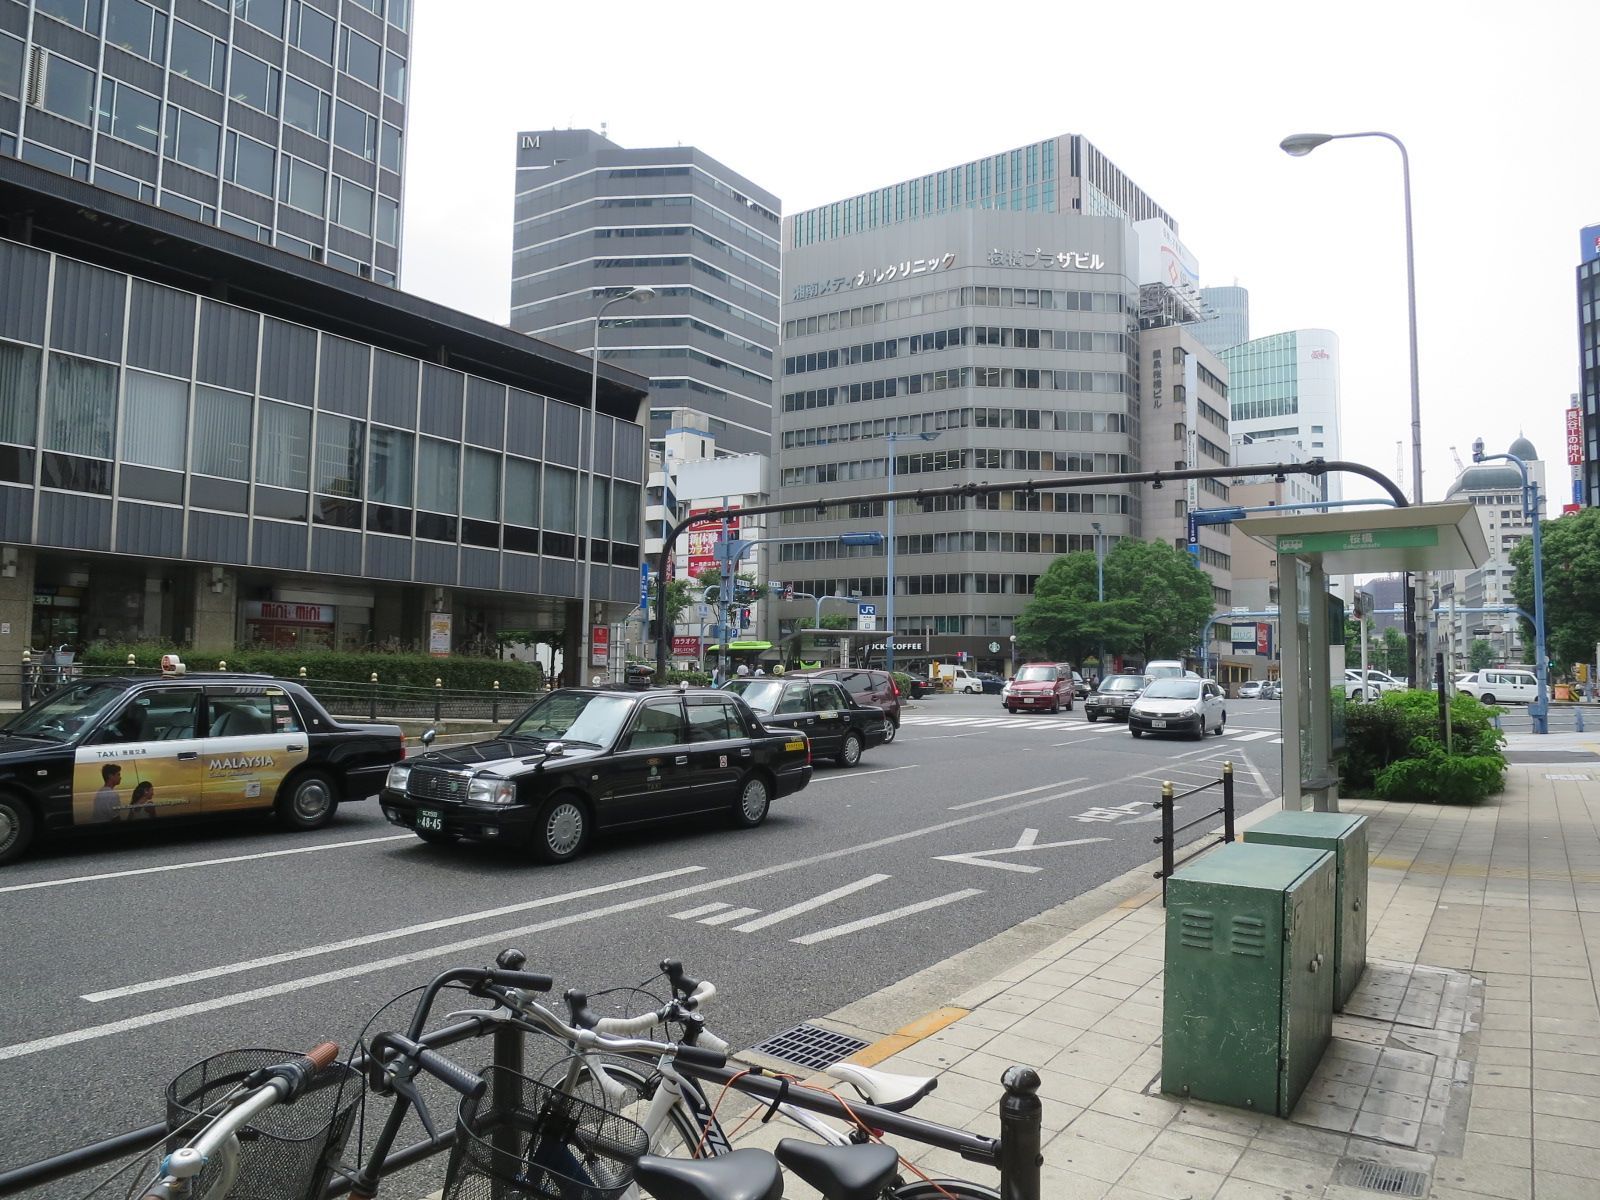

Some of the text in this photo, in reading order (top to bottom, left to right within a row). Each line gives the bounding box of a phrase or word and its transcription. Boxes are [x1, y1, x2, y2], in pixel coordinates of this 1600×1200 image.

[520, 135, 541, 149] IM
[793, 252, 956, 301] 湘南メディカルクリニック
[295, 606, 320, 620] mini
[861, 606, 874, 614] JR
[209, 756, 275, 771] MALAYSIA
[421, 816, 442, 830] 48-45
